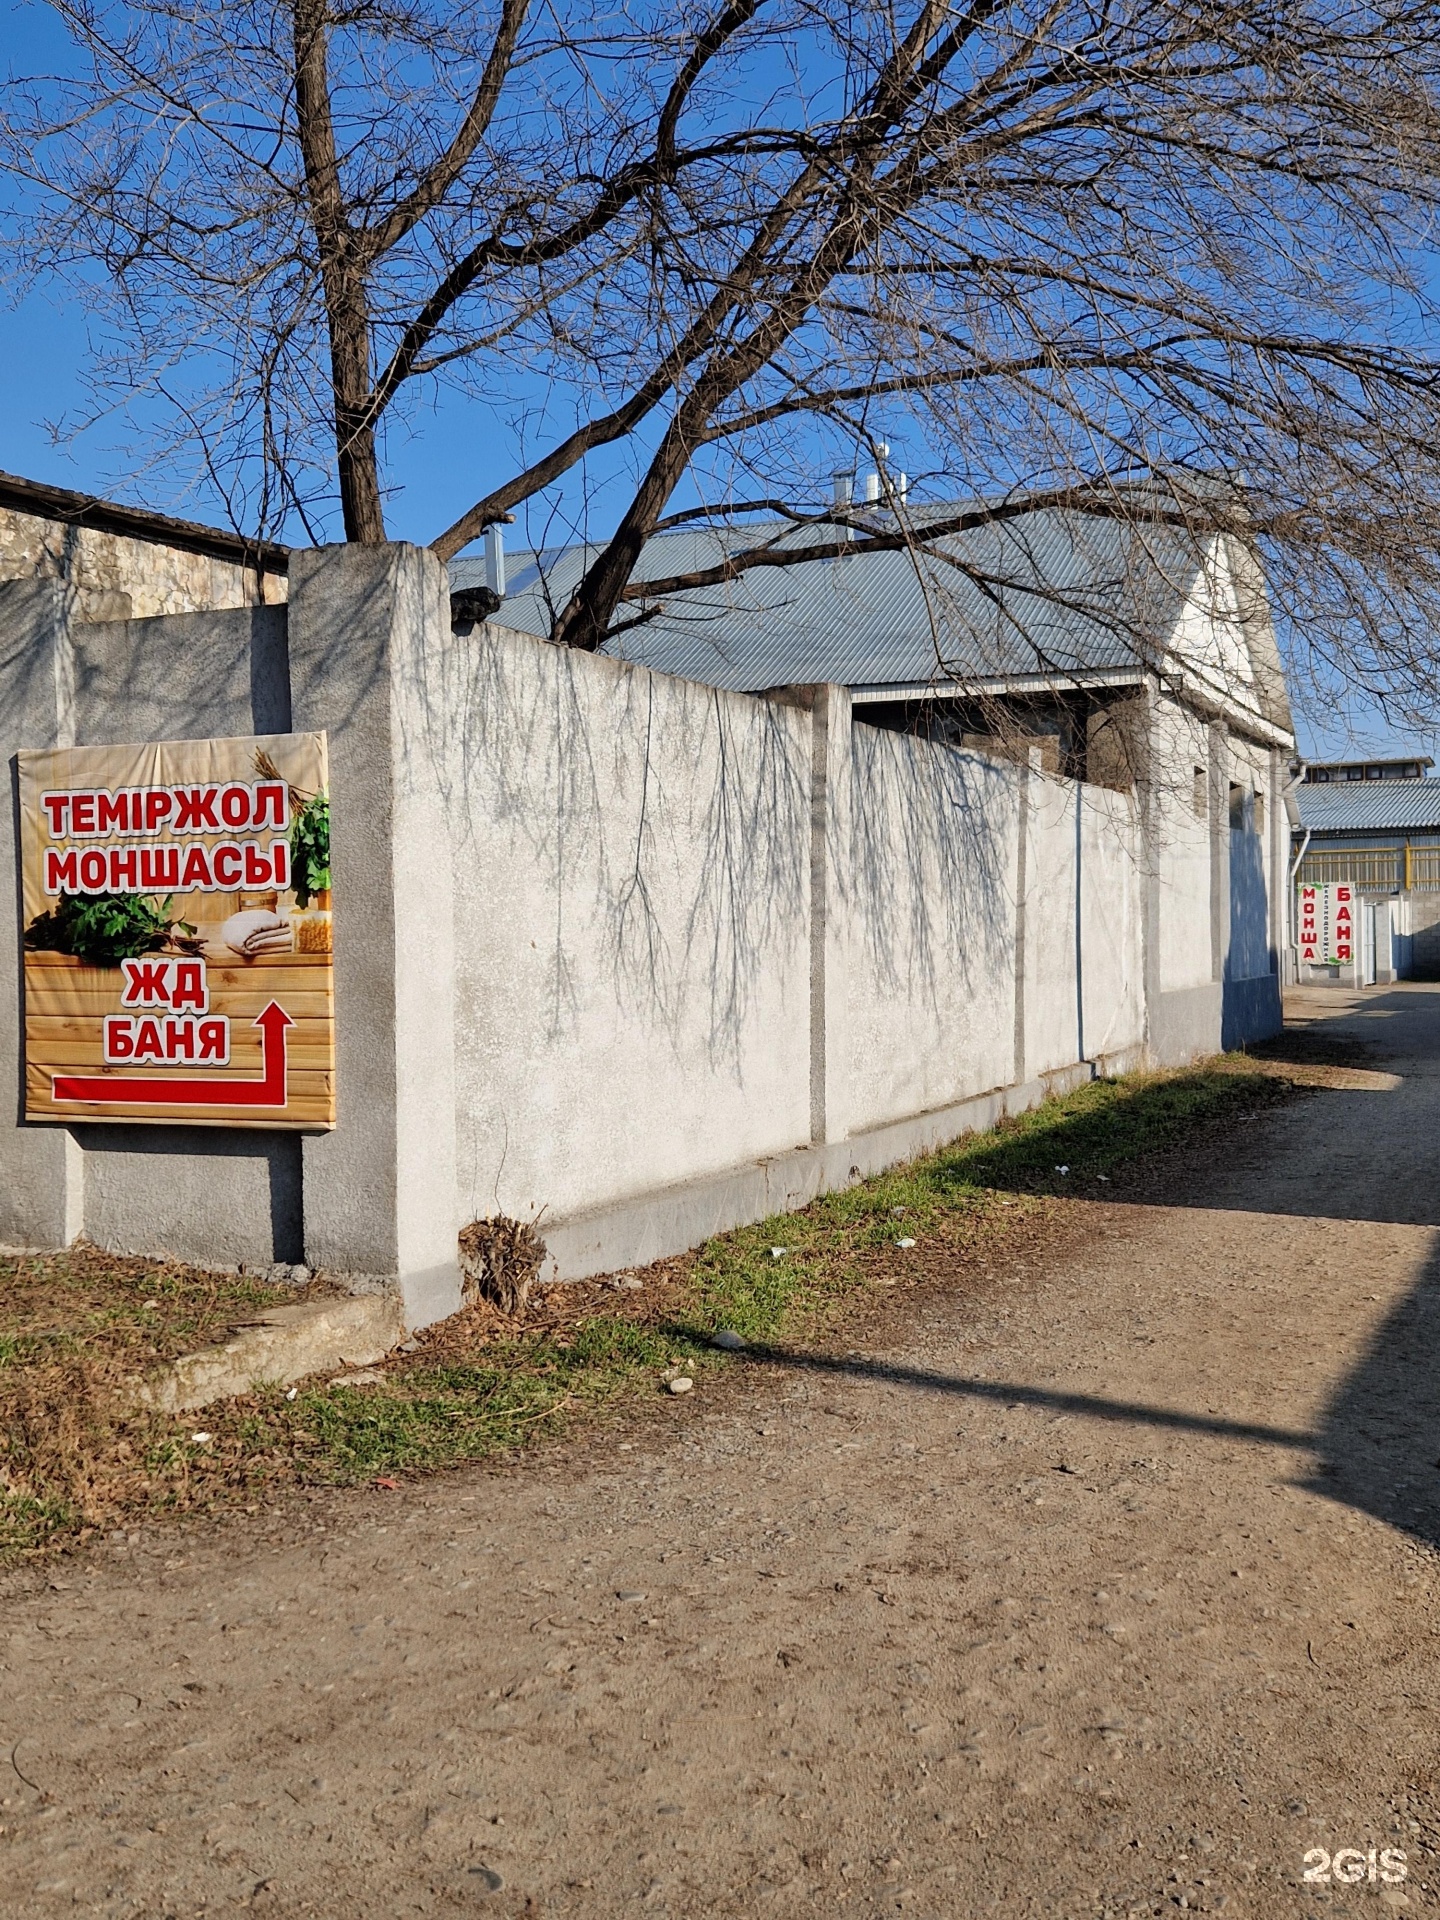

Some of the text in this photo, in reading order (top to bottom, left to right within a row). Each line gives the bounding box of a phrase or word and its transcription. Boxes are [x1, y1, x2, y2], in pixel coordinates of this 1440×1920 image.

[44, 785, 285, 833] ТЕМІРЖОЛ
[47, 844, 287, 890] МОНШАСЫ
[1300, 888, 1318, 959] МОНША
[1336, 887, 1352, 960] БАНЯ
[125, 963, 206, 1010] ЖД
[107, 1020, 226, 1059] БАНЯ
